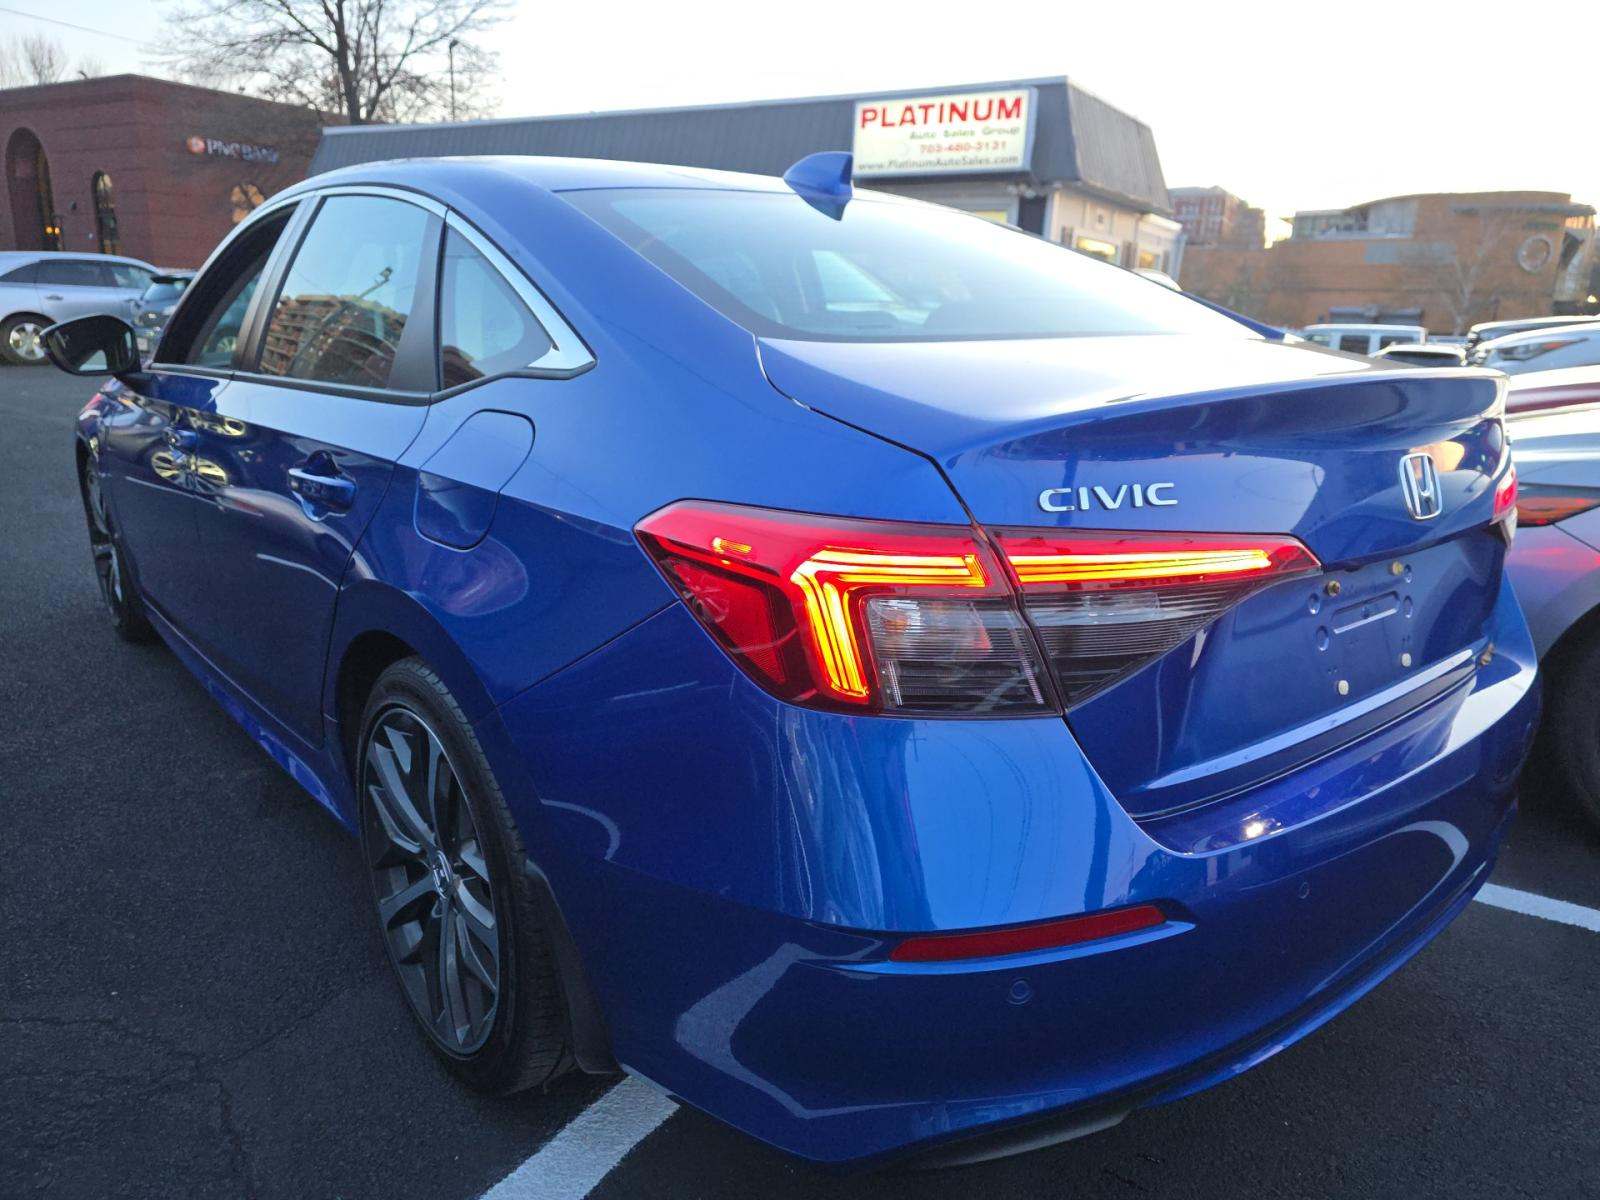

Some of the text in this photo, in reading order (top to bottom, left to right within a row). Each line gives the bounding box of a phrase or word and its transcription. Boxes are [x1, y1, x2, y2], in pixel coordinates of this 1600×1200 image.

[860, 96, 1022, 128] PLATINUM
[909, 126, 1020, 140] Auto Sales Group
[858, 155, 1019, 170] www.PlatinumAutoSales.com
[1038, 482, 1178, 512] CIVIC
